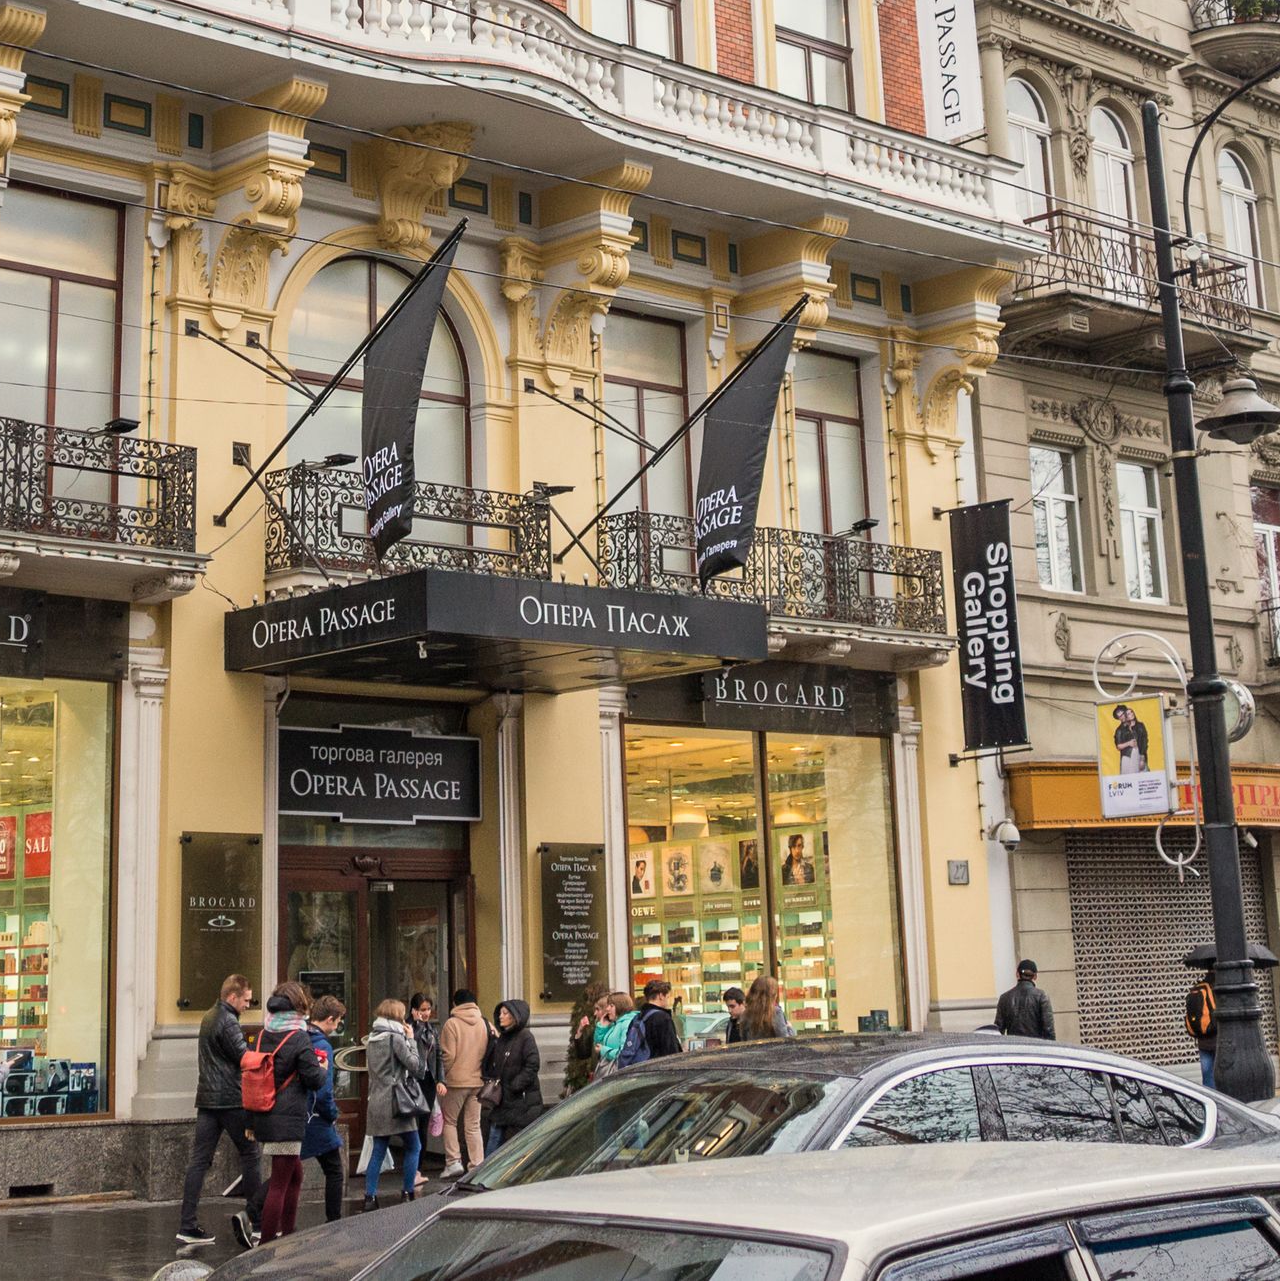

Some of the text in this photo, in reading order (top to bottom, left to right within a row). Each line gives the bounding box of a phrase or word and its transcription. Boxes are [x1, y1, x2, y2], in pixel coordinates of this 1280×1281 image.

[935, 6, 961, 127] PASSAGE
[696, 485, 739, 523] OPERA
[706, 539, 738, 558] Галерея
[252, 598, 396, 649] OPERA PASSAGE
[520, 596, 690, 637] ОПЕРА ПАСАЖ
[963, 571, 988, 689] Gallery
[986, 542, 1016, 704] Shopping
[715, 677, 844, 707] BROCARD
[310, 745, 443, 769] торгова галерея
[290, 769, 461, 801] OPERA PASSAGE
[189, 896, 256, 908] BROCARD
[631, 906, 655, 917] OEWE
[552, 931, 599, 940] OPERA PASSAGE
